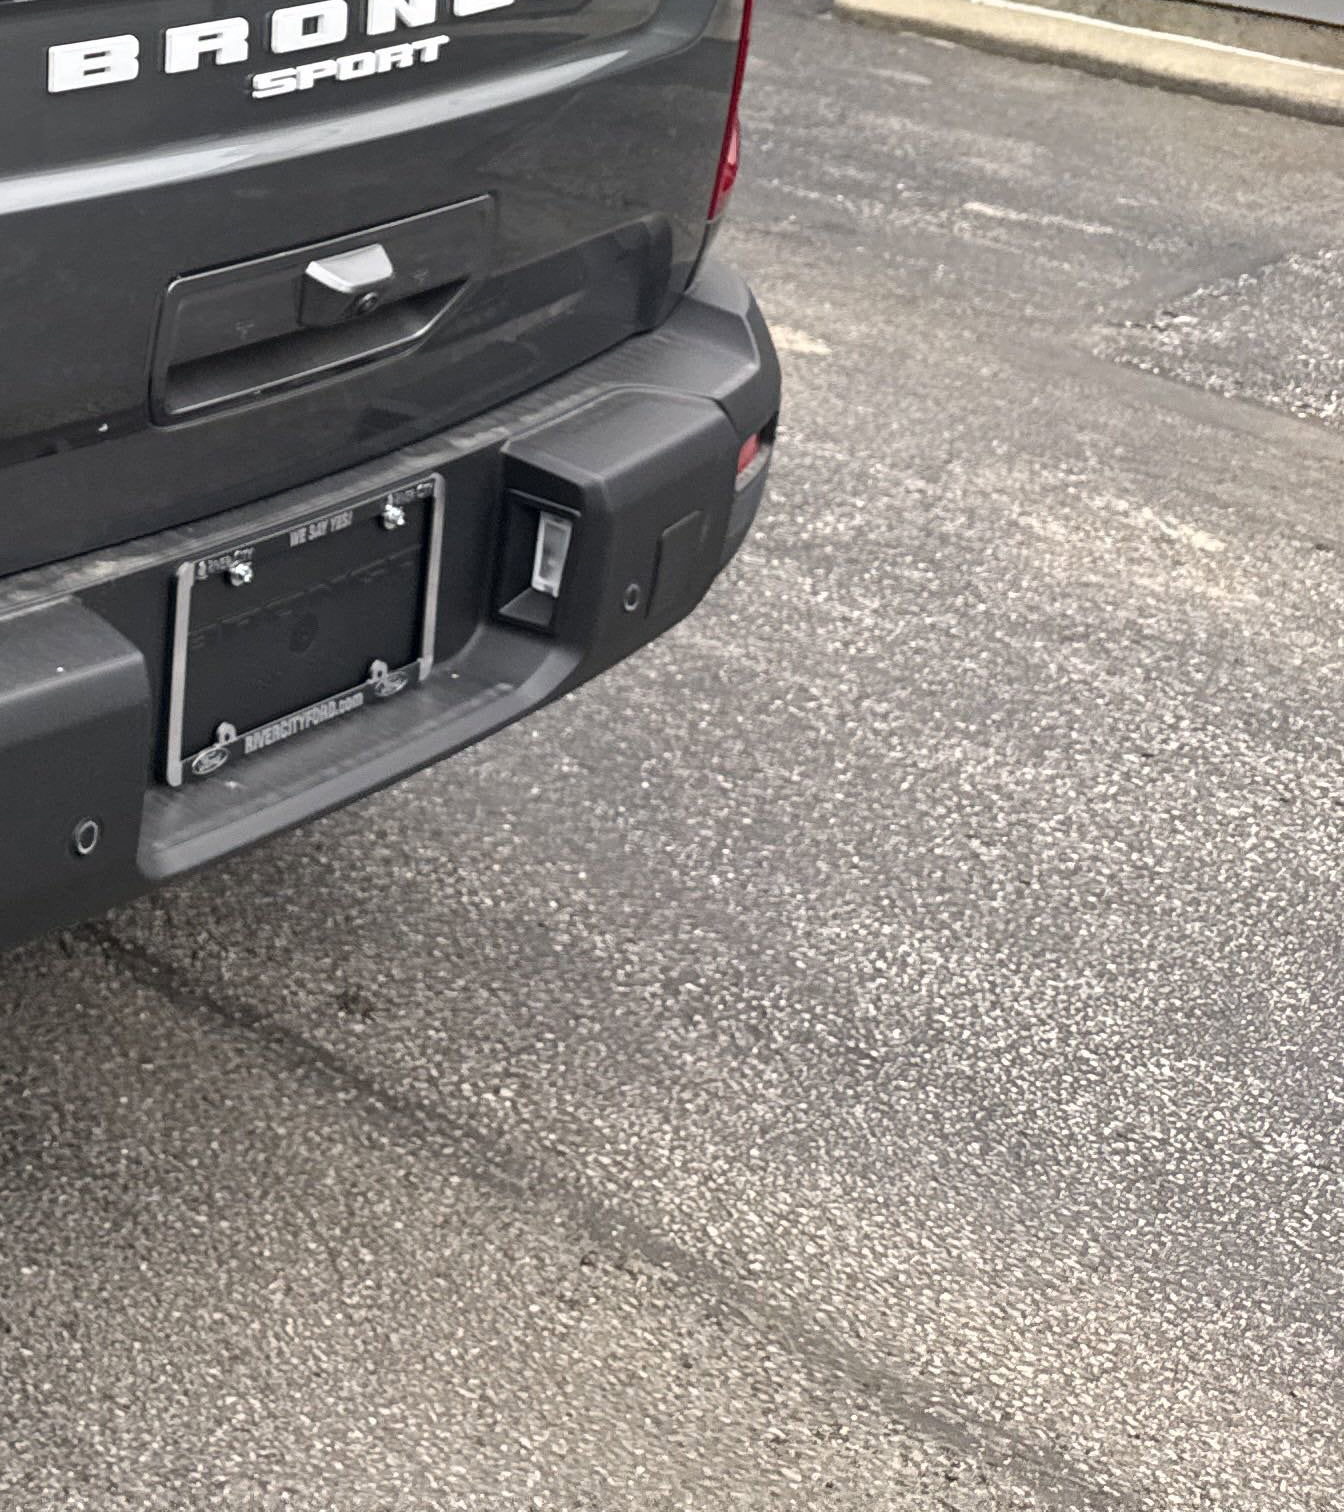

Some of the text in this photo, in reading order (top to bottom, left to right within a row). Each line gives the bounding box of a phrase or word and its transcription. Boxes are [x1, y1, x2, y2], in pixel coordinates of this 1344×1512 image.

[250, 34, 450, 98] SPORT
[308, 518, 329, 541] SAY
[244, 691, 364, 755] RIVERCITYFORD.com
